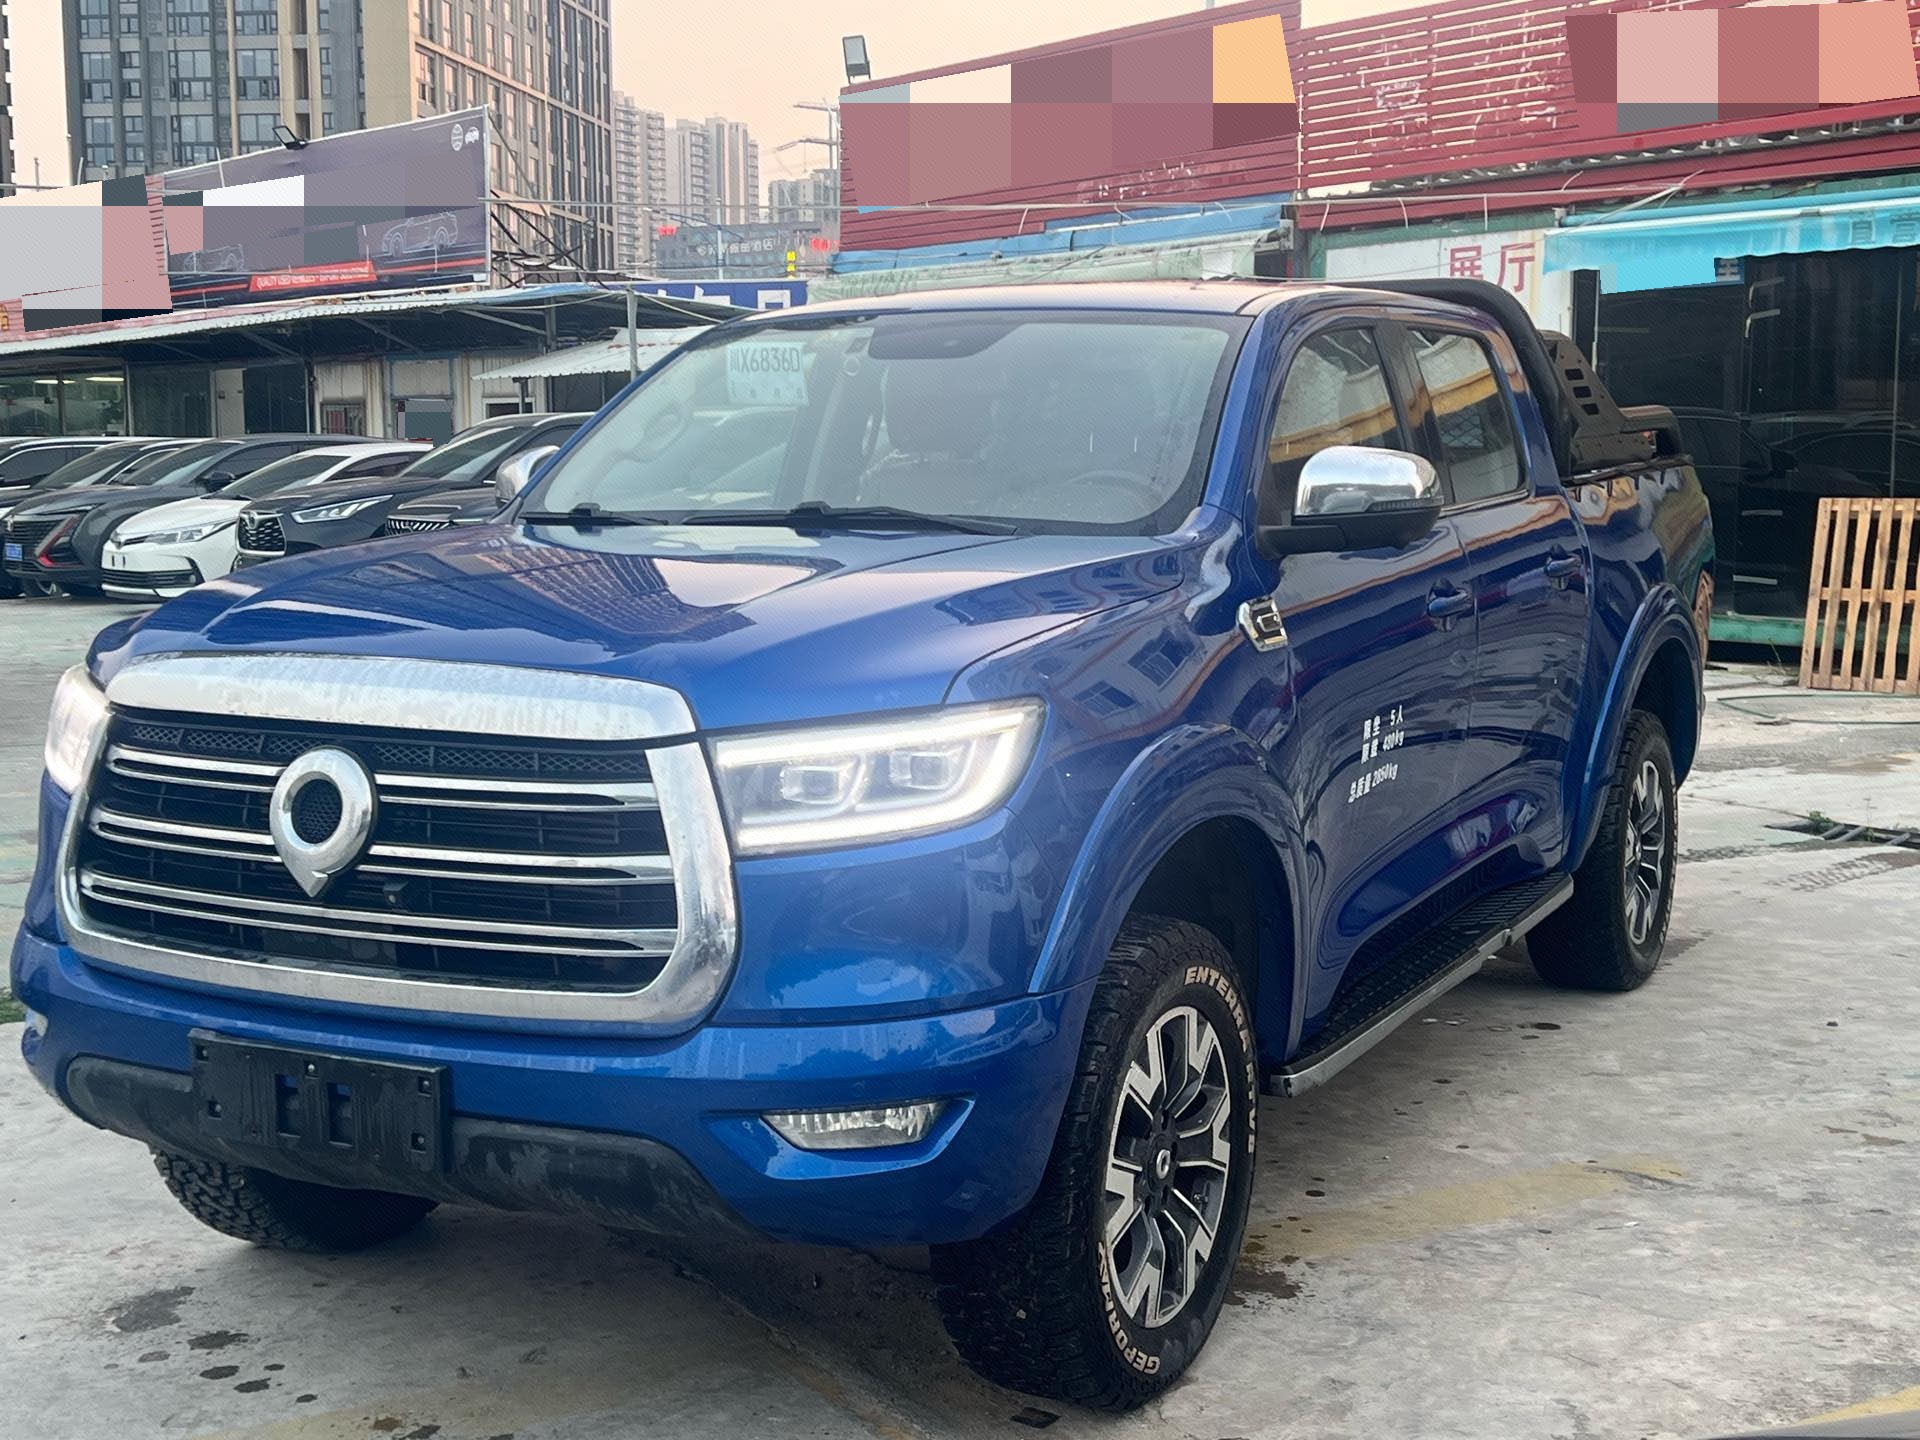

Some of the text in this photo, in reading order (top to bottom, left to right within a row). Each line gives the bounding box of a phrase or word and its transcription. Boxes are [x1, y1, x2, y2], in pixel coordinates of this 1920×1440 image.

[1449, 242, 1536, 293] 展厅
[1184, 966, 1251, 1053] ENTERRA
[1097, 1241, 1161, 1375] GEPORMAX
